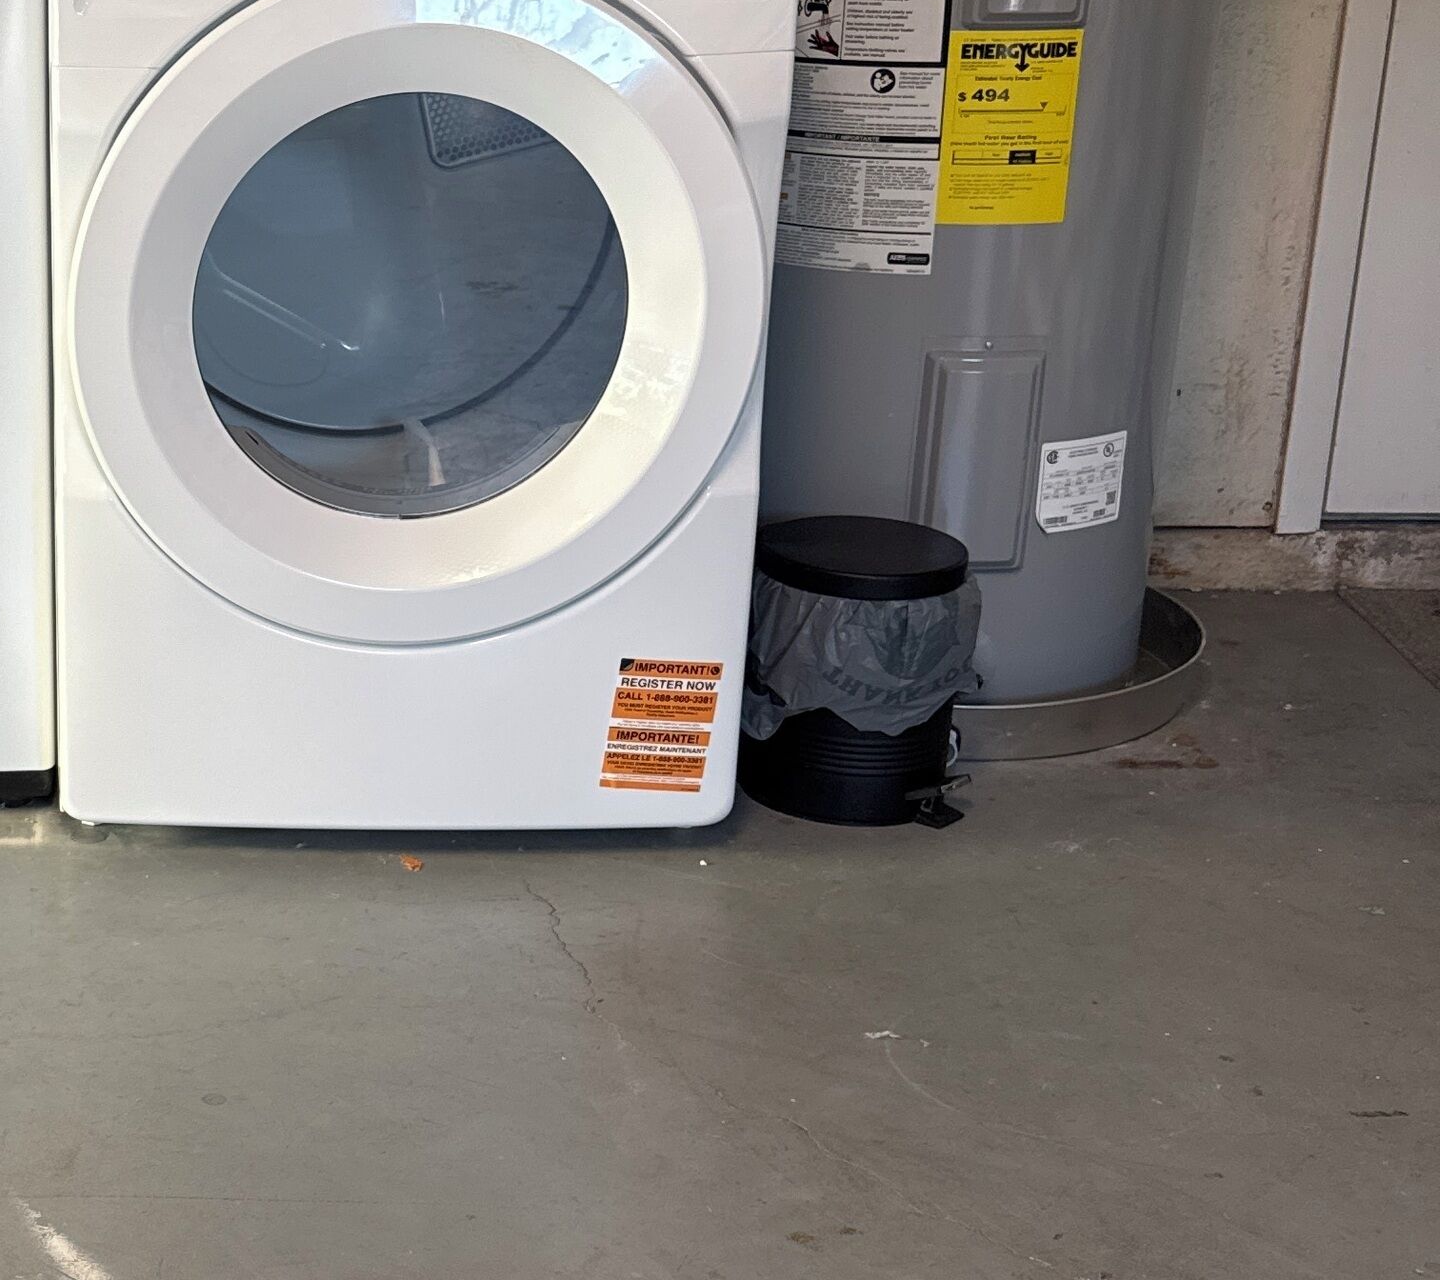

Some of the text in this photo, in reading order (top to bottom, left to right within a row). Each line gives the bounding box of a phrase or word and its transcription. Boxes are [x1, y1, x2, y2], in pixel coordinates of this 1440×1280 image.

[958, 88, 1010, 102] $ 494
[634, 662, 710, 675] IMPORTANT!
[620, 677, 716, 691] REGISTER NOW
[617, 691, 643, 700] CALL
